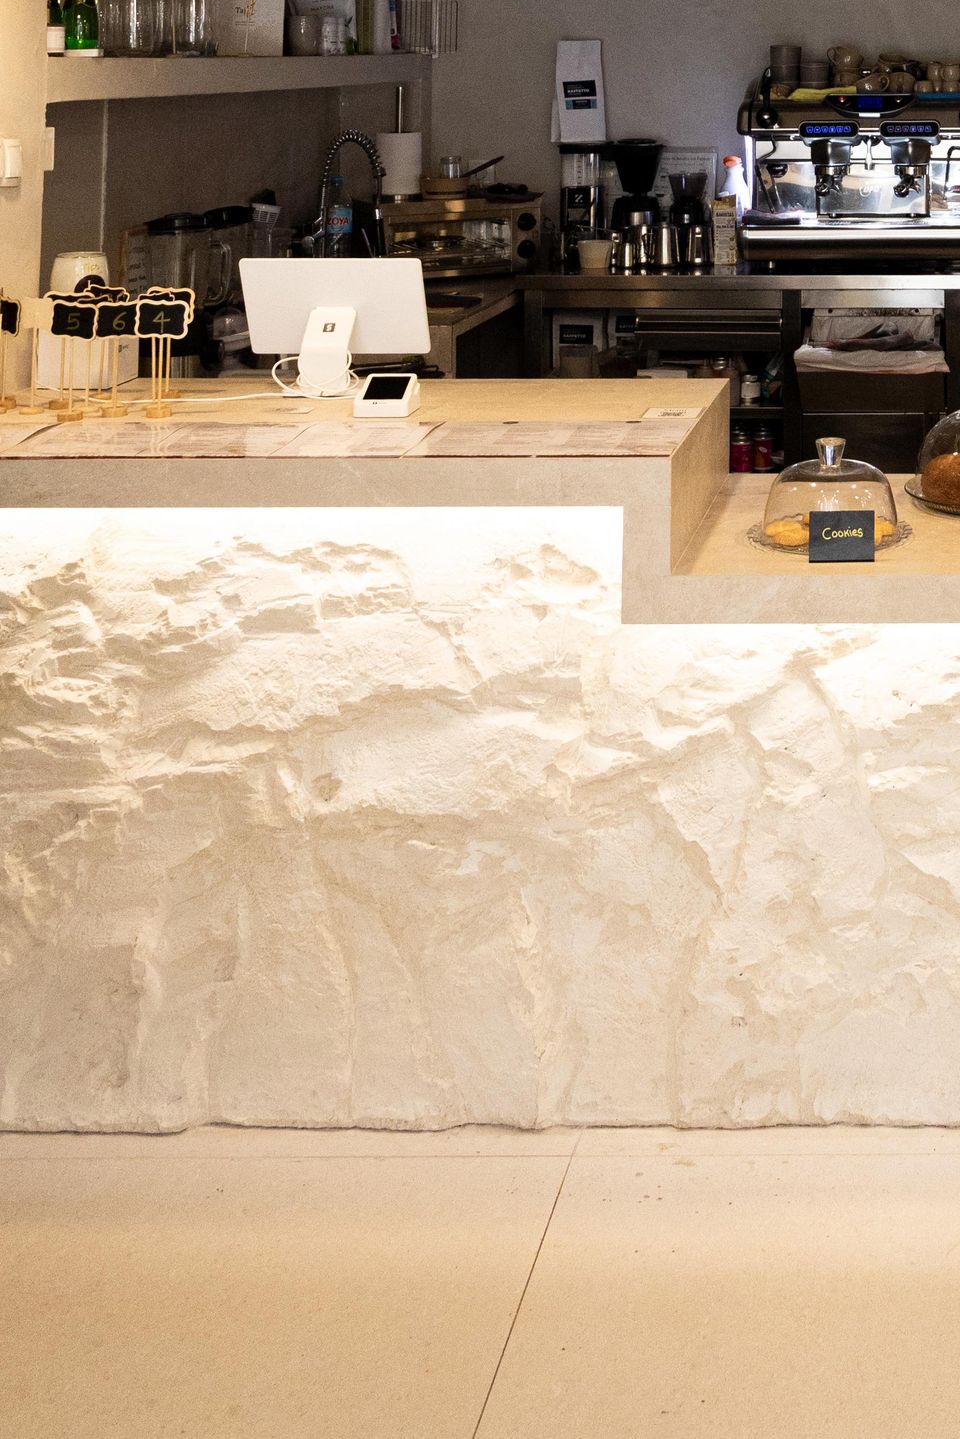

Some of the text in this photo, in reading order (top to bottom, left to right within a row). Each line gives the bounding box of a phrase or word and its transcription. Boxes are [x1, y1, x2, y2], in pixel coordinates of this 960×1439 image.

[66, 313, 81, 330] 5
[112, 312, 127, 330] 6
[152, 311, 171, 333] 4
[821, 526, 864, 540] Cookies
